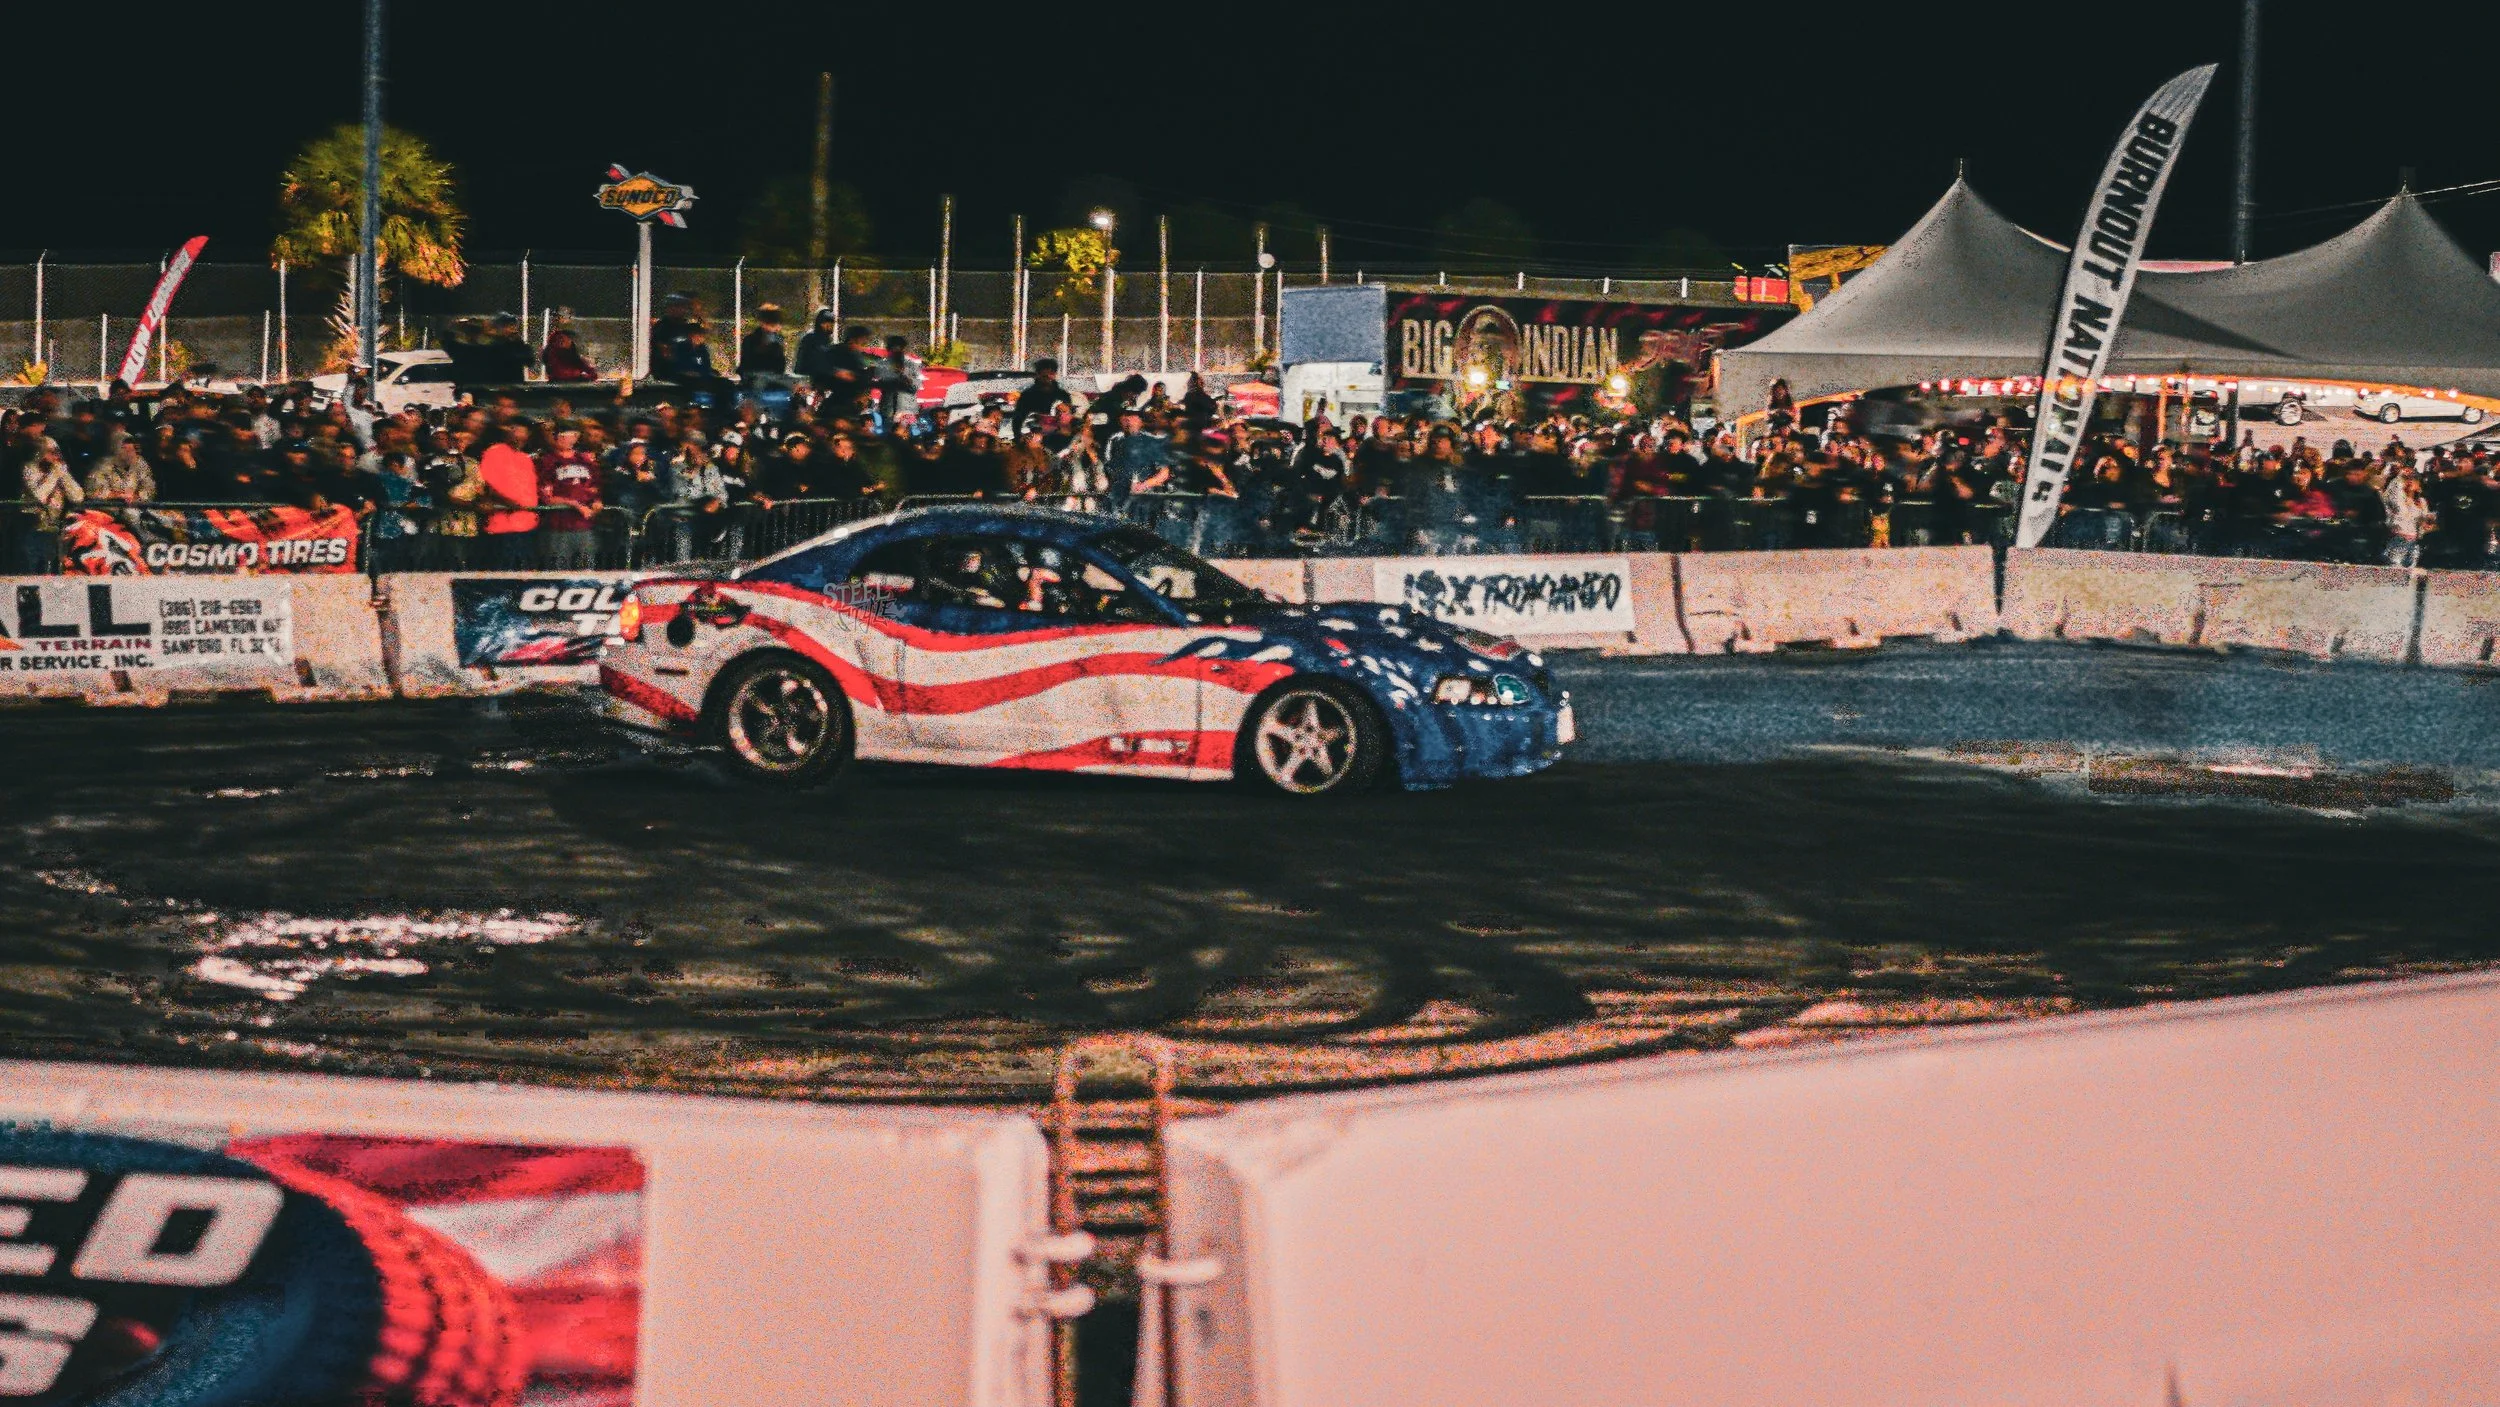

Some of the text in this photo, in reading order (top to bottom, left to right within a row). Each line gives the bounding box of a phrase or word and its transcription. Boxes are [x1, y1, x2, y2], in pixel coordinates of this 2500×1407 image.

[605, 188, 678, 204] SUNOCO
[2082, 111, 2178, 291] BURNOUT
[1402, 318, 1618, 379] BIG INDIAN
[148, 537, 347, 567] COSMO TIRES
[0, 584, 150, 638] LL
[36, 638, 151, 652] TERRAIN
[19, 654, 108, 671] SERVICE,
[113, 652, 154, 669] INC.
